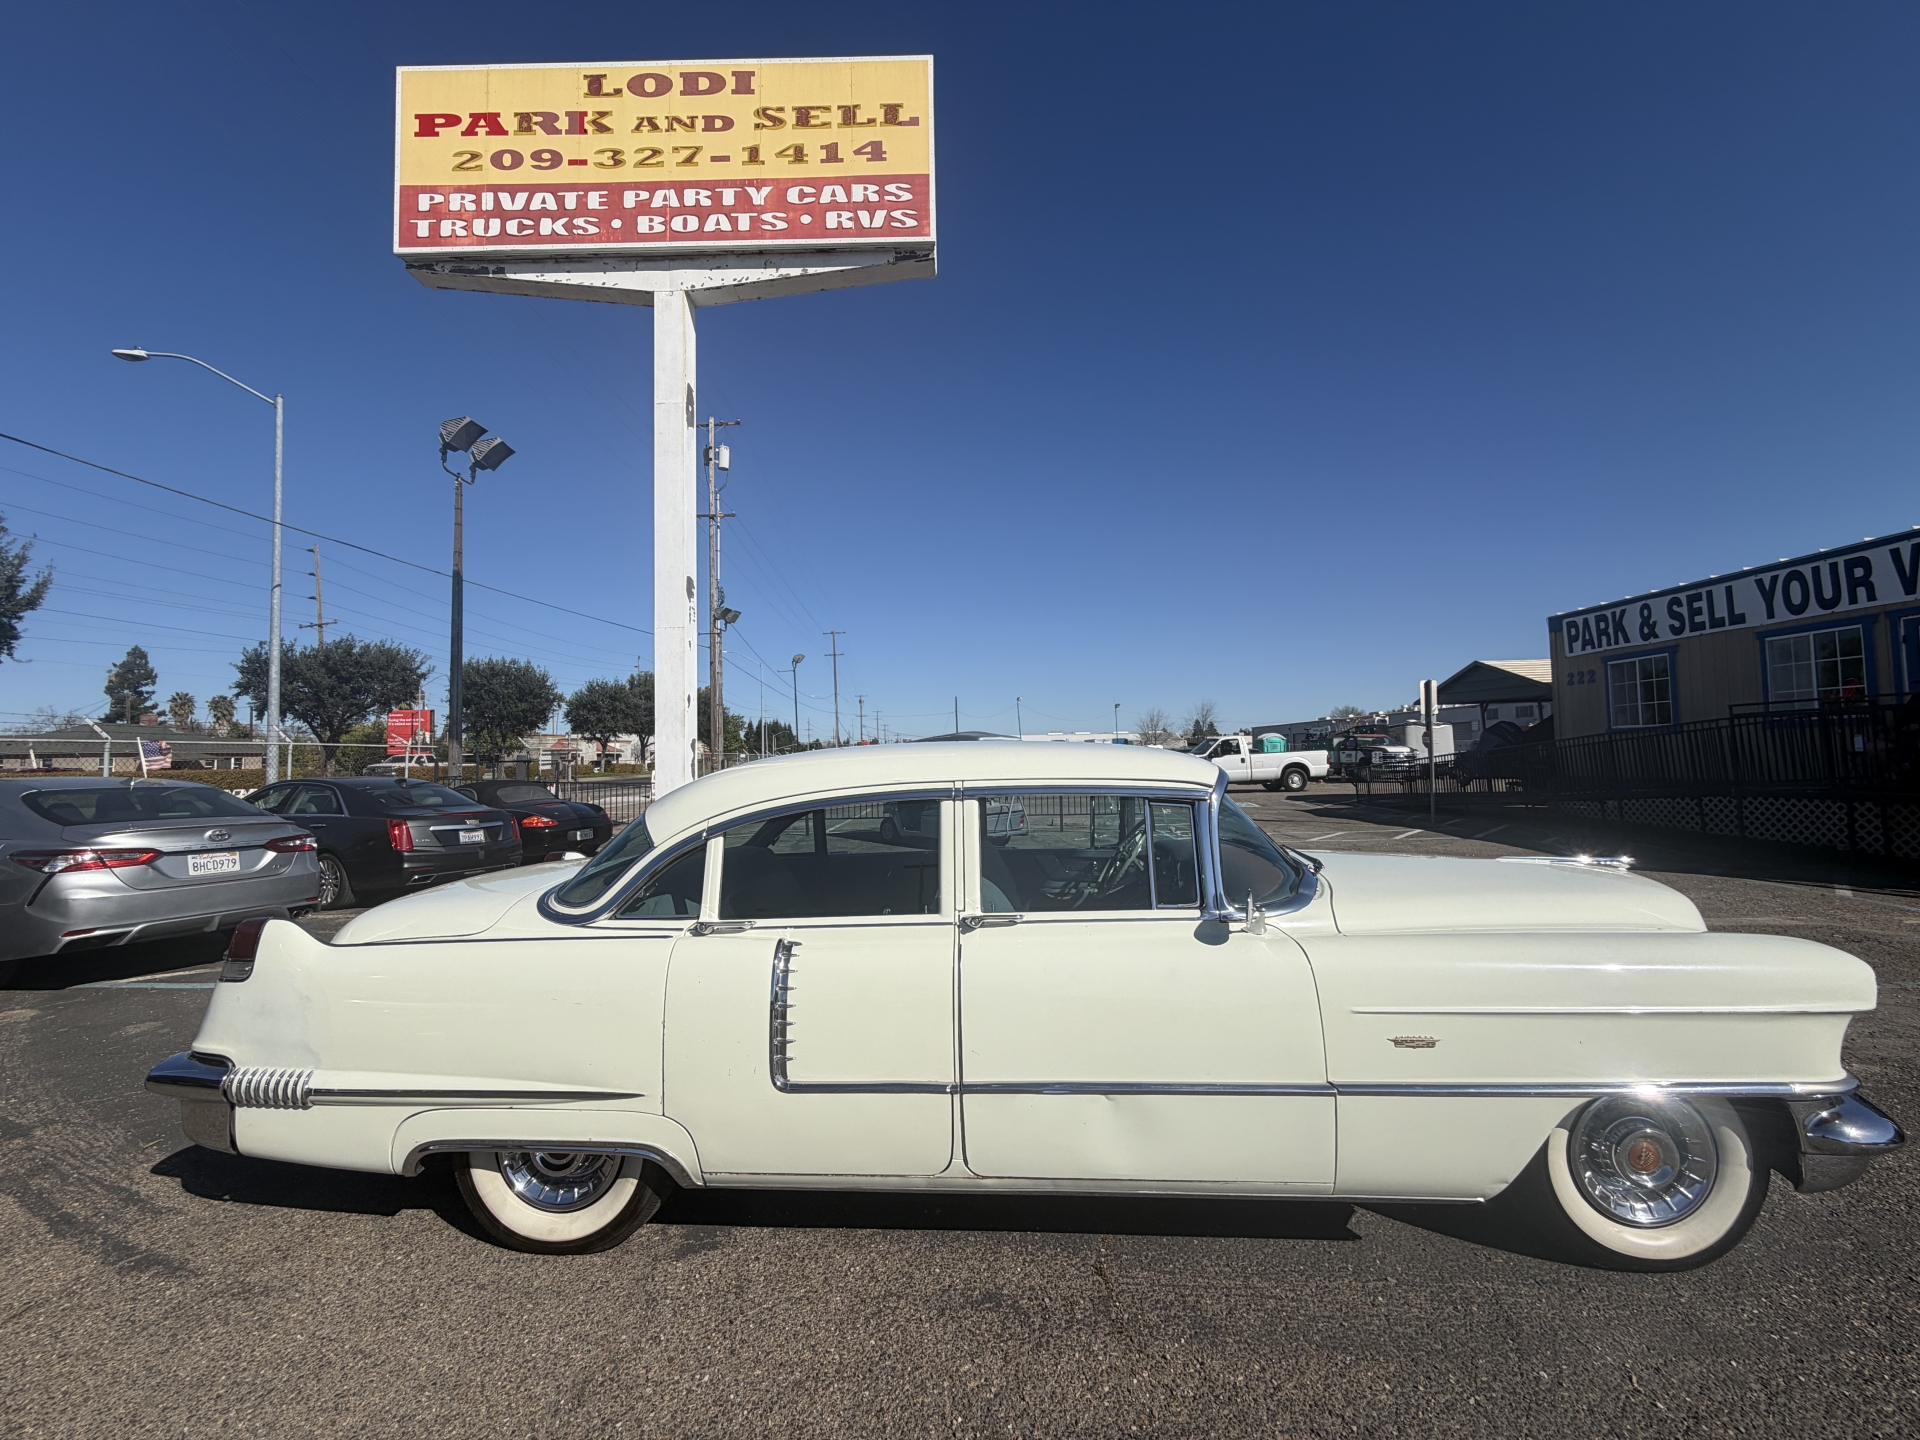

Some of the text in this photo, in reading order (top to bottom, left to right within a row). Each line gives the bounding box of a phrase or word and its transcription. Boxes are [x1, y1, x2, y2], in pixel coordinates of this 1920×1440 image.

[583, 70, 756, 99] LODI
[414, 102, 920, 137] PARK AND SELL
[451, 140, 887, 172] 209-327-1414
[417, 183, 914, 212] PRIVATE PARTY CARS
[409, 209, 919, 238] TRUCKS BOATS RVS
[1566, 608, 1631, 654] PARK
[1638, 602, 1660, 642] &
[1666, 585, 1746, 636] SELL
[1754, 555, 1877, 620] YOUR
[1567, 669, 1596, 686] 222
[192, 858, 237, 872] 8HCD979
